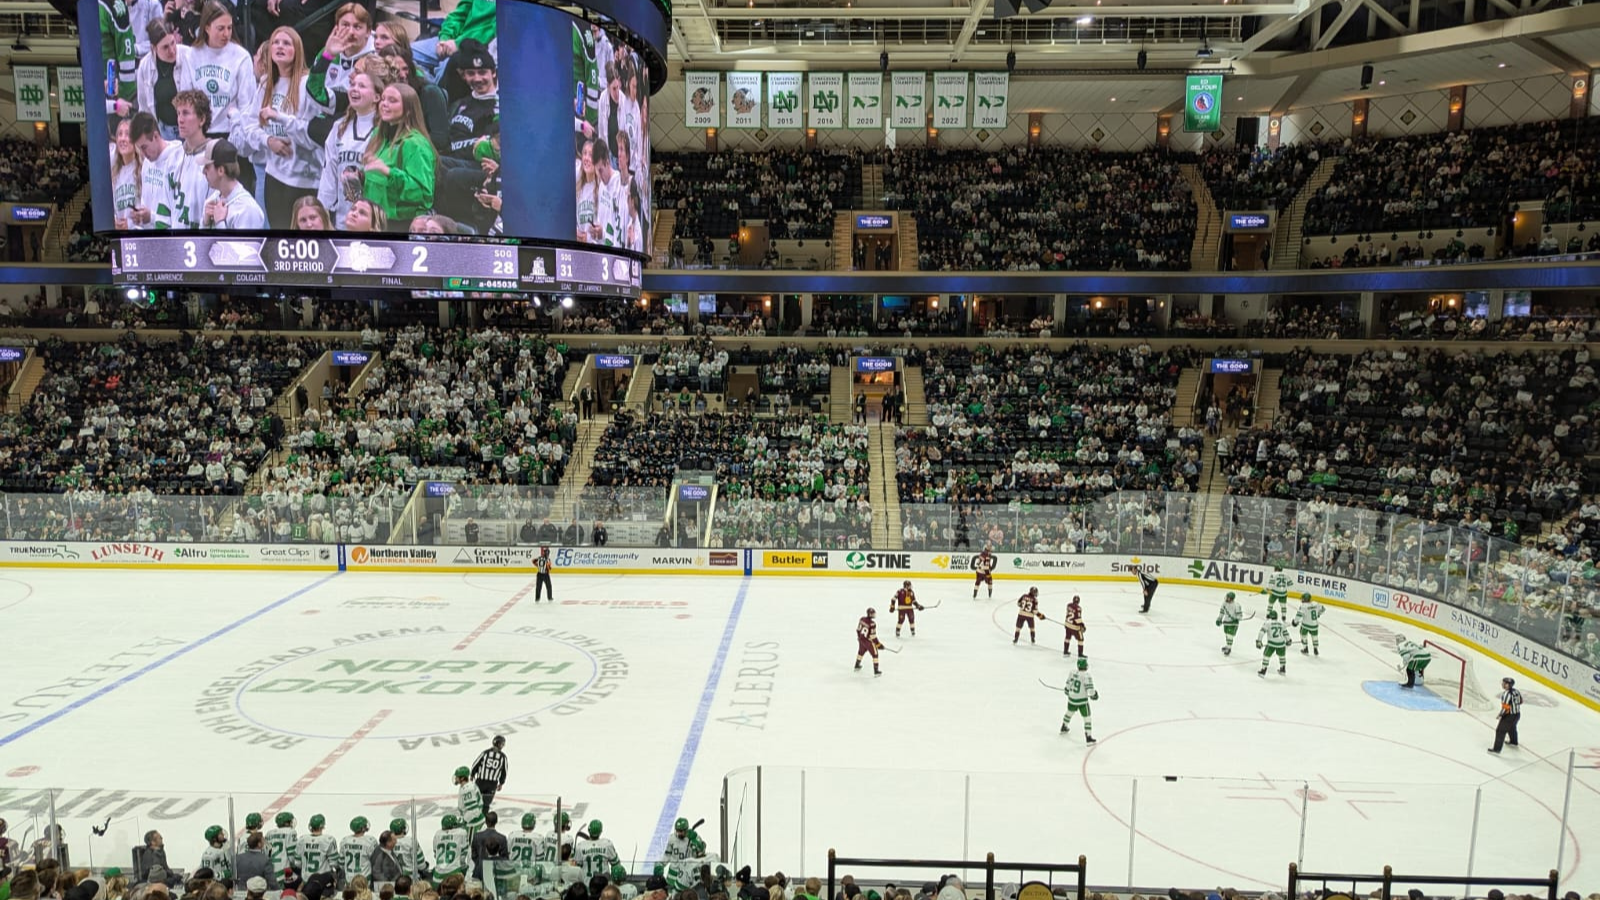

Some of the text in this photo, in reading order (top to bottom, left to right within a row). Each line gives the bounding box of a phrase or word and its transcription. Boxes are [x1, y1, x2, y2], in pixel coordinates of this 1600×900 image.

[125, 39, 131, 54] 8
[184, 241, 197, 268] 3
[277, 239, 320, 260] 6:00
[494, 250, 512, 258] SOG
[125, 254, 138, 268] 31
[412, 246, 428, 272] 2
[560, 254, 572, 262] SOG
[274, 260, 324, 272] 3RD PERIOD
[492, 261, 514, 274] 28
[560, 264, 573, 277] 31
[602, 257, 608, 281] 3
[382, 277, 402, 286] FINAL
[91, 543, 164, 562] LUNSETH
[181, 548, 207, 558] Altru
[260, 547, 310, 557] Great Clips
[370, 548, 437, 560] Northern Valley
[474, 548, 532, 558] Greenberg
[557, 549, 574, 558] FC
[592, 552, 639, 560] Community
[476, 556, 511, 566] Realty
[555, 558, 572, 566] CU
[653, 557, 692, 565] MARVIN
[772, 556, 806, 565] Butler
[813, 556, 826, 564] CAT
[867, 554, 911, 569] STINE
[1204, 562, 1264, 586] Altru
[1298, 575, 1348, 592] BREMER
[1324, 589, 1346, 599] BANK
[1375, 592, 1388, 604] gm
[1392, 593, 1438, 620] Rydell
[1451, 610, 1500, 639] SANFORD
[1460, 628, 1489, 644] HEALTH
[316, 659, 575, 675] NORTH
[1511, 640, 1569, 680] ALERUS
[195, 626, 446, 751] RALPH ENGELSTAD ARENA
[246, 679, 578, 695] DAKOTA
[398, 626, 629, 751] RALPH ENGELSTAD ARENA
[716, 642, 780, 730] ALERUS
[486, 760, 500, 770] 50
[464, 791, 473, 801] 20
[436, 842, 457, 865] 26
[304, 852, 321, 872] 15
[345, 852, 361, 873] 21
